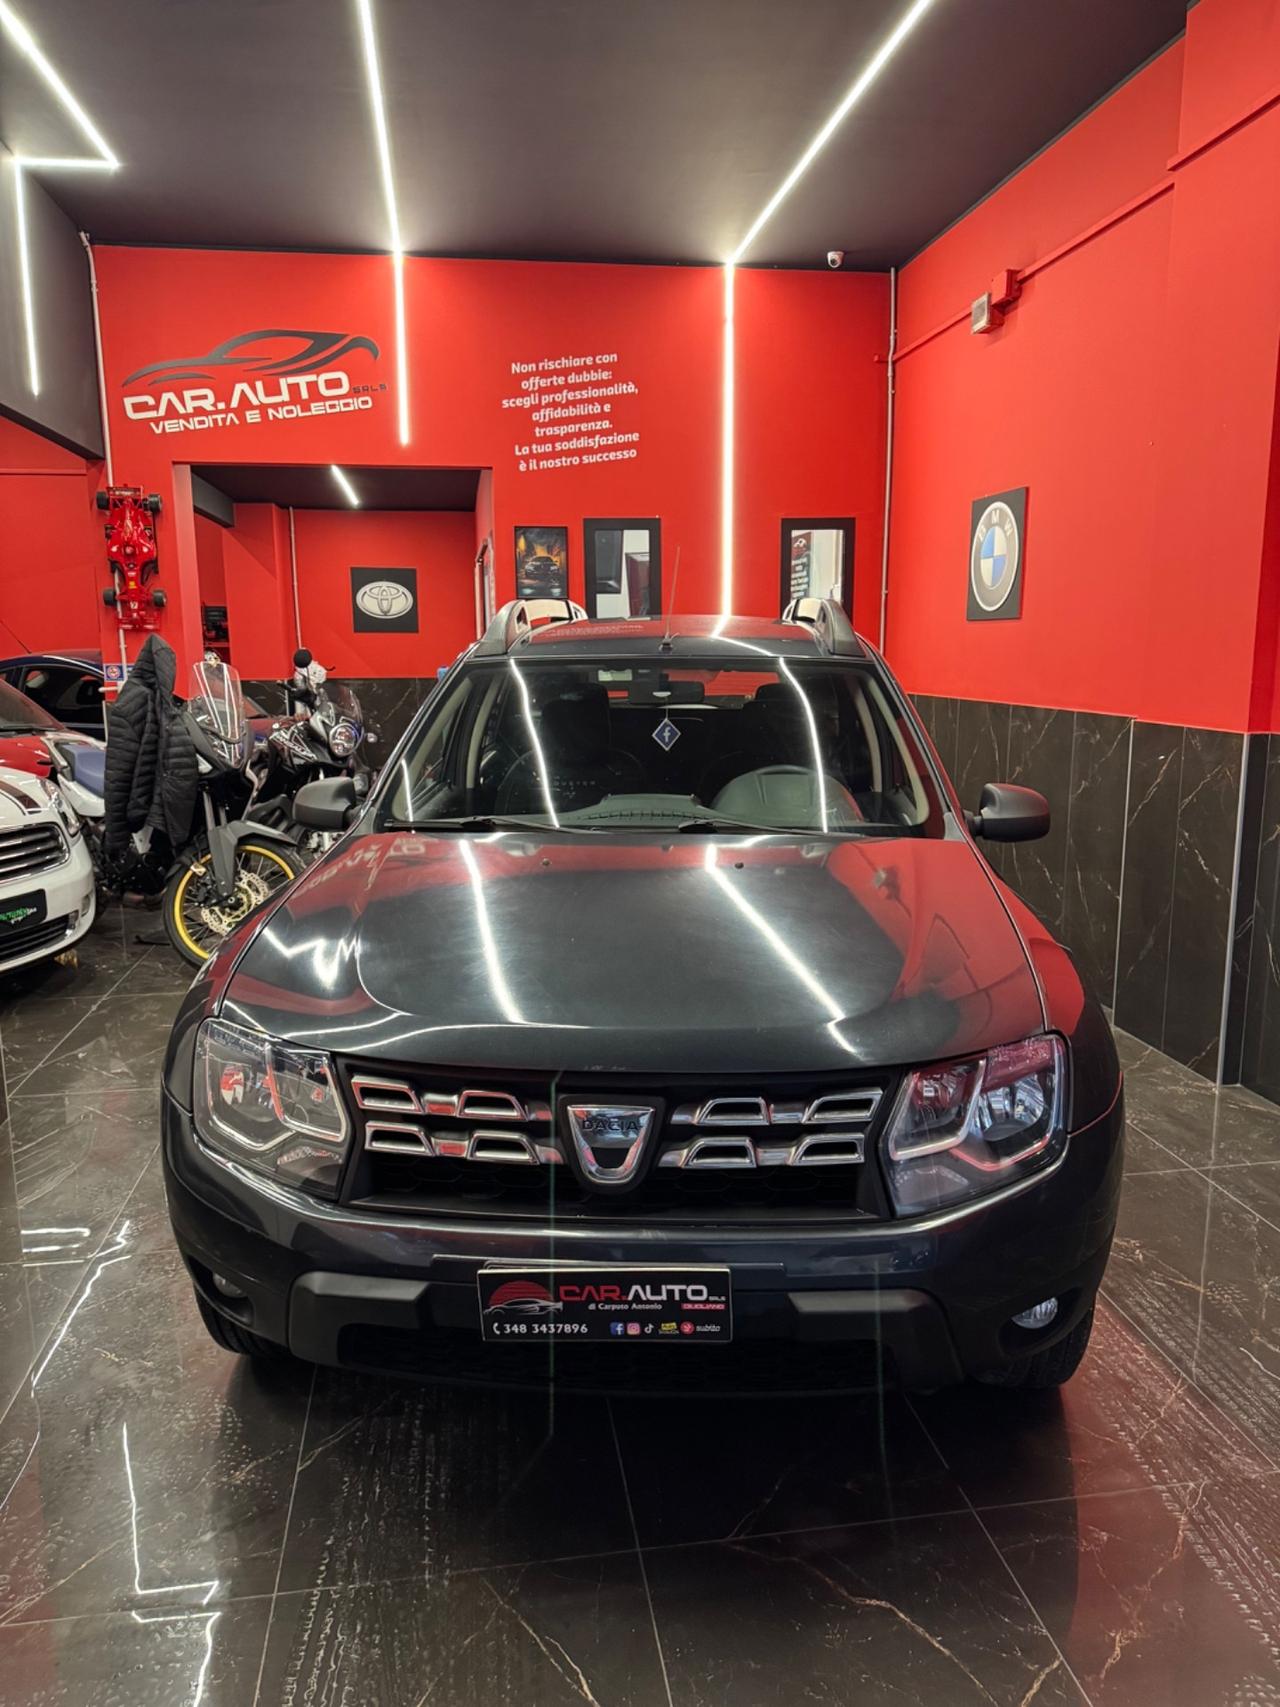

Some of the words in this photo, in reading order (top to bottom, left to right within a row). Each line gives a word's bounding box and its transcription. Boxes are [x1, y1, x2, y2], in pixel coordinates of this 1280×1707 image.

[511, 362, 536, 374] Non
[538, 356, 593, 371] rischiare
[595, 353, 618, 364] con
[521, 375, 565, 391] offerte
[567, 369, 612, 384] dubbie:
[123, 371, 350, 420] CAR.AUTO
[501, 393, 539, 409] scegli
[541, 382, 639, 406] professionalità,
[150, 414, 239, 434] VENDITA
[245, 409, 261, 424] E
[268, 396, 373, 421] NOLEGGIO
[532, 402, 601, 422] affidabilità
[603, 403, 611, 413] e
[534, 419, 613, 437] trasparenza.
[514, 444, 529, 456] La
[531, 443, 552, 454] tua
[555, 432, 640, 451] soddisfazione
[519, 460, 527, 472] è
[529, 458, 537, 471] il
[540, 455, 580, 469] nostro
[582, 448, 637, 464] successo
[979, 509, 1013, 541] BMW
[582, 1116, 639, 1131] DACIA
[559, 1284, 708, 1301] CAR.AUTO
[588, 1302, 596, 1310] di
[631, 1302, 663, 1310] Antonio
[503, 1323, 527, 1334] 348
[532, 1323, 589, 1334] 3437896
